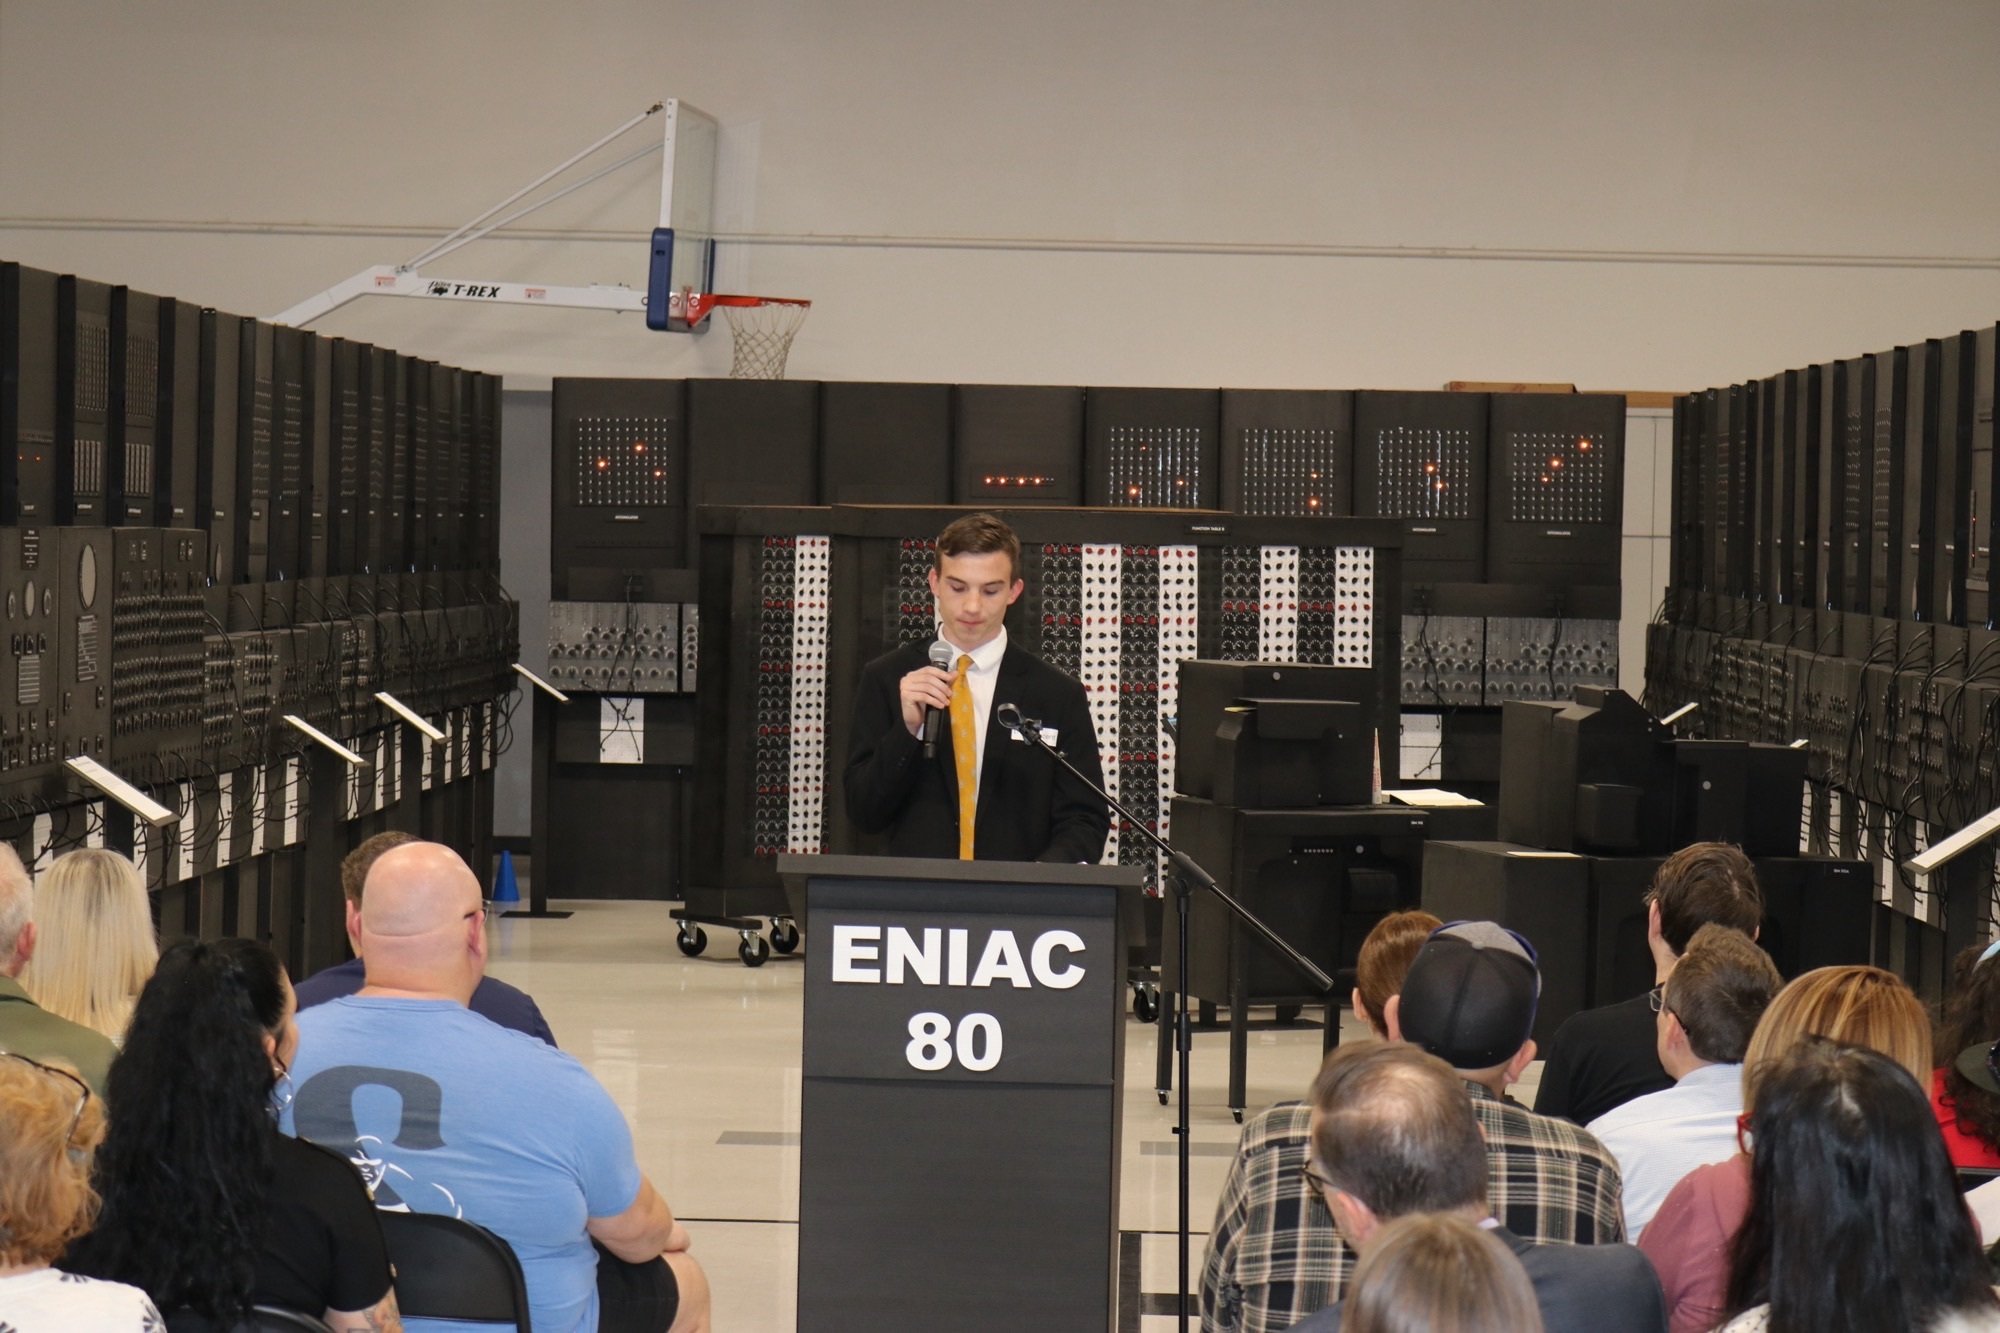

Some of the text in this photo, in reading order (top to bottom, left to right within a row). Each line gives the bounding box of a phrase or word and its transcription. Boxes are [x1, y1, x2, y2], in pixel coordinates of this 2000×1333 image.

[454, 284, 501, 298] T-REX
[832, 925, 1086, 989] ENIAC
[905, 1012, 1003, 1072] 80
